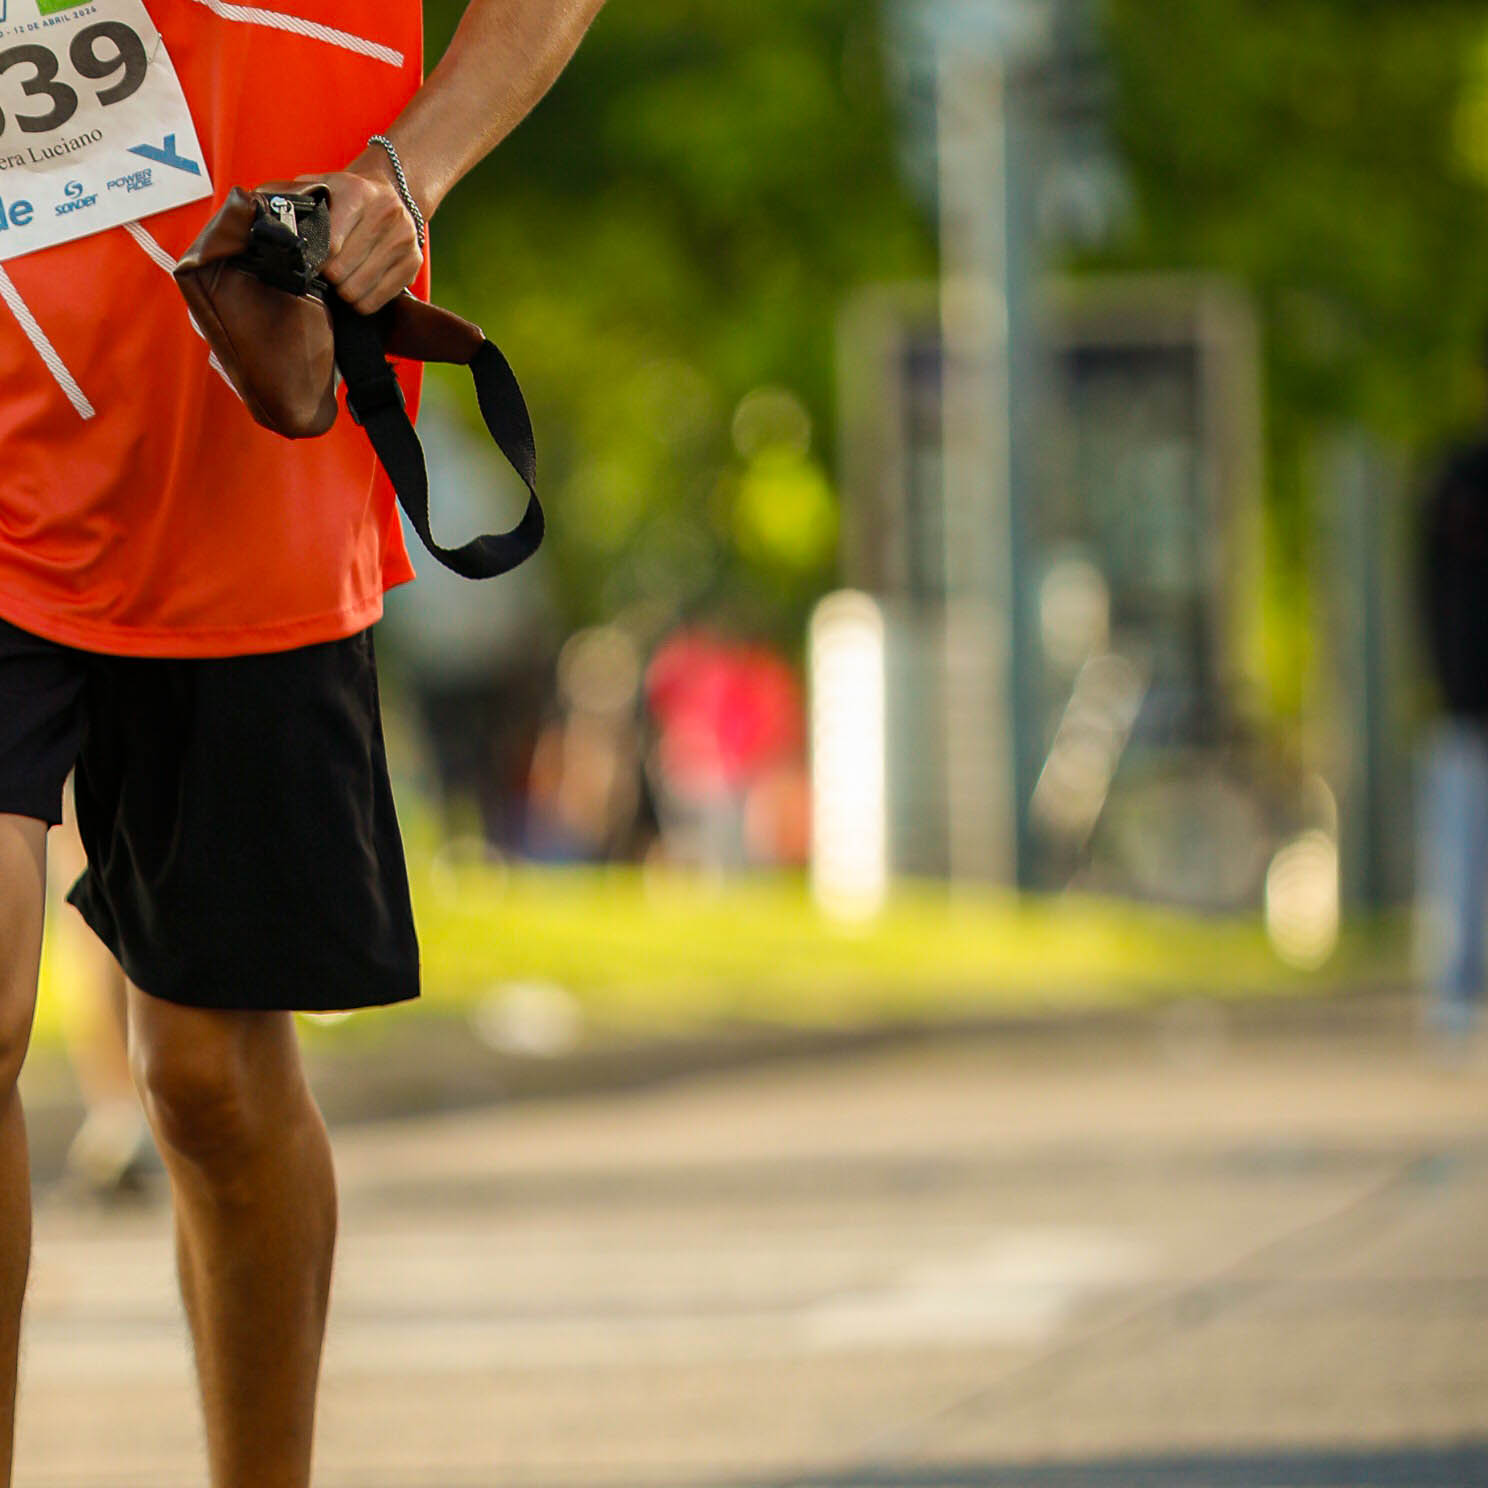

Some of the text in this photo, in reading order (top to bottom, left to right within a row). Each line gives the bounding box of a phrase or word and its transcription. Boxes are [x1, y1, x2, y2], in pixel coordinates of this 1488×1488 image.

[14, 25, 25, 35] 12
[27, 22, 40, 32] DE
[42, 16, 71, 28] ABRIL
[73, 6, 98, 20] 2026
[30, 127, 103, 164] Luciano
[106, 168, 152, 191] POWER
